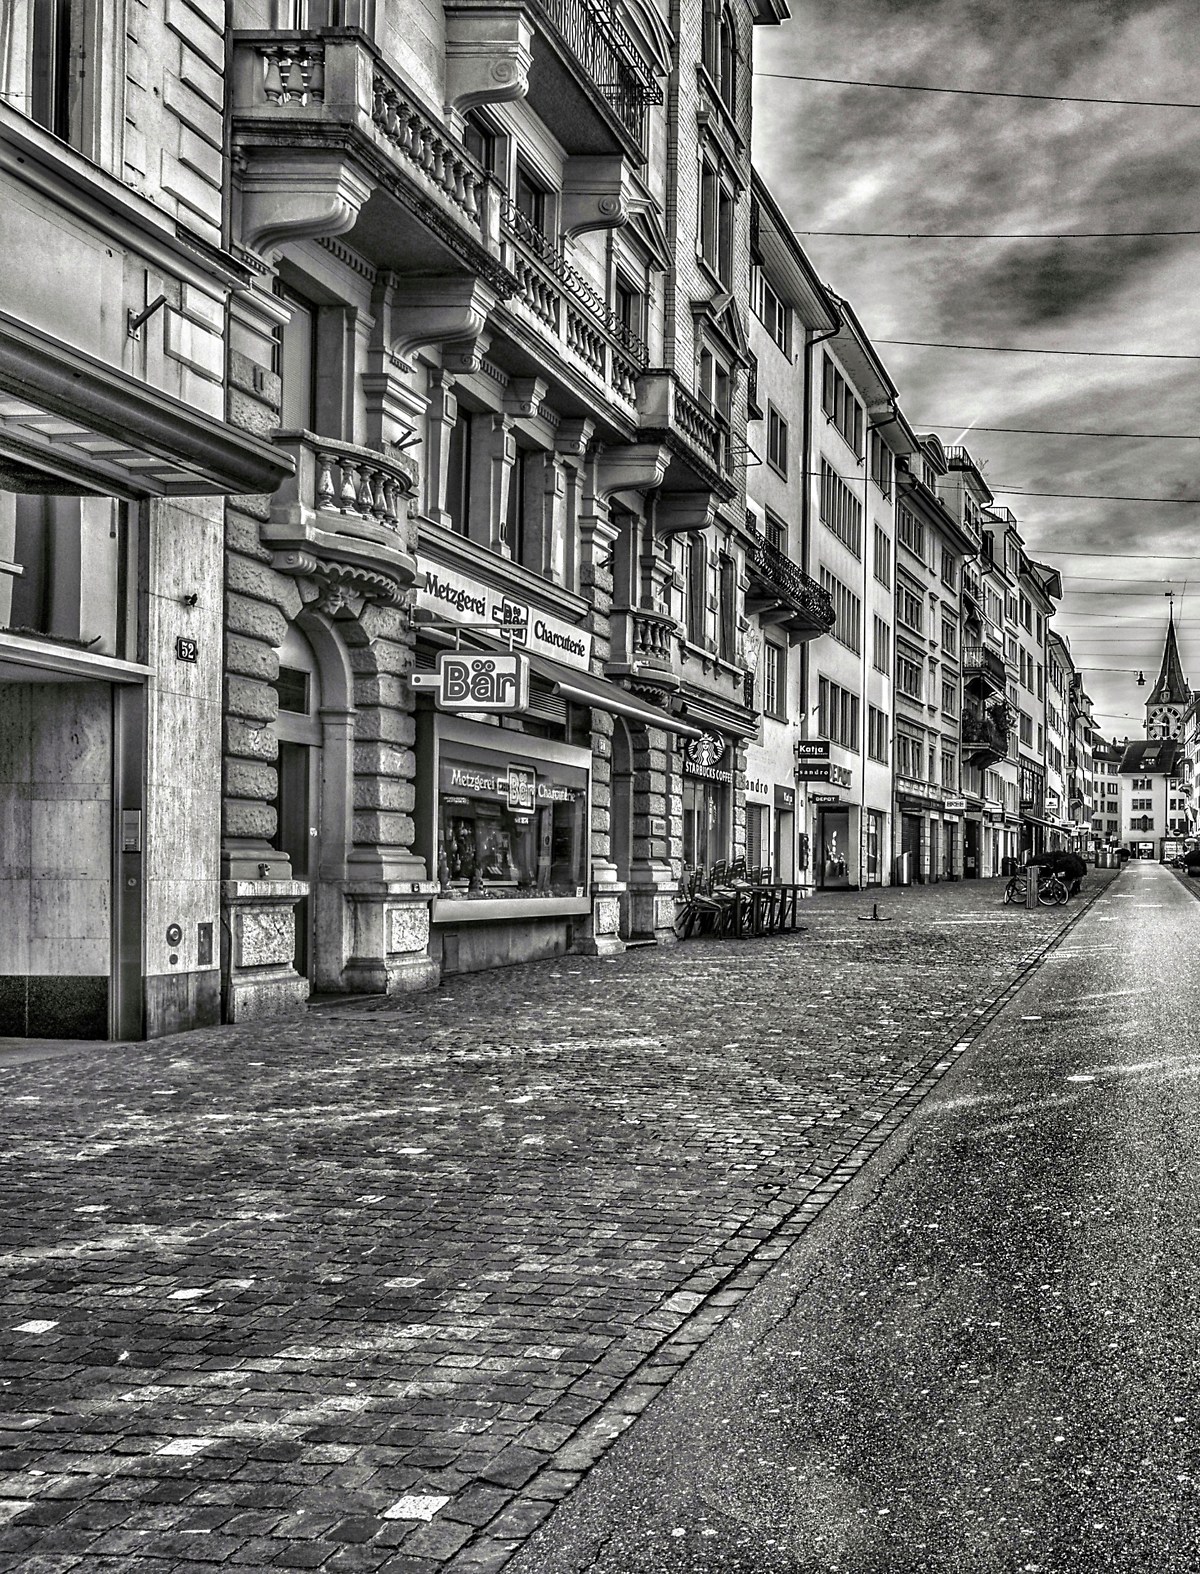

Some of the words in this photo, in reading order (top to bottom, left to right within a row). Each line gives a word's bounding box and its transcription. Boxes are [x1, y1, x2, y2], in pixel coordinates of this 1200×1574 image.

[423, 571, 486, 617] Metzgerei
[533, 619, 586, 657] Charcuterie
[181, 641, 194, 659] 52
[443, 660, 516, 702] Bär
[800, 745, 824, 755] Katja
[685, 761, 716, 779] STARBUCKS
[716, 770, 733, 783] COFFEE
[451, 768, 495, 791] Metzgerei
[509, 772, 536, 807] Bär
[745, 778, 769, 795] andro
